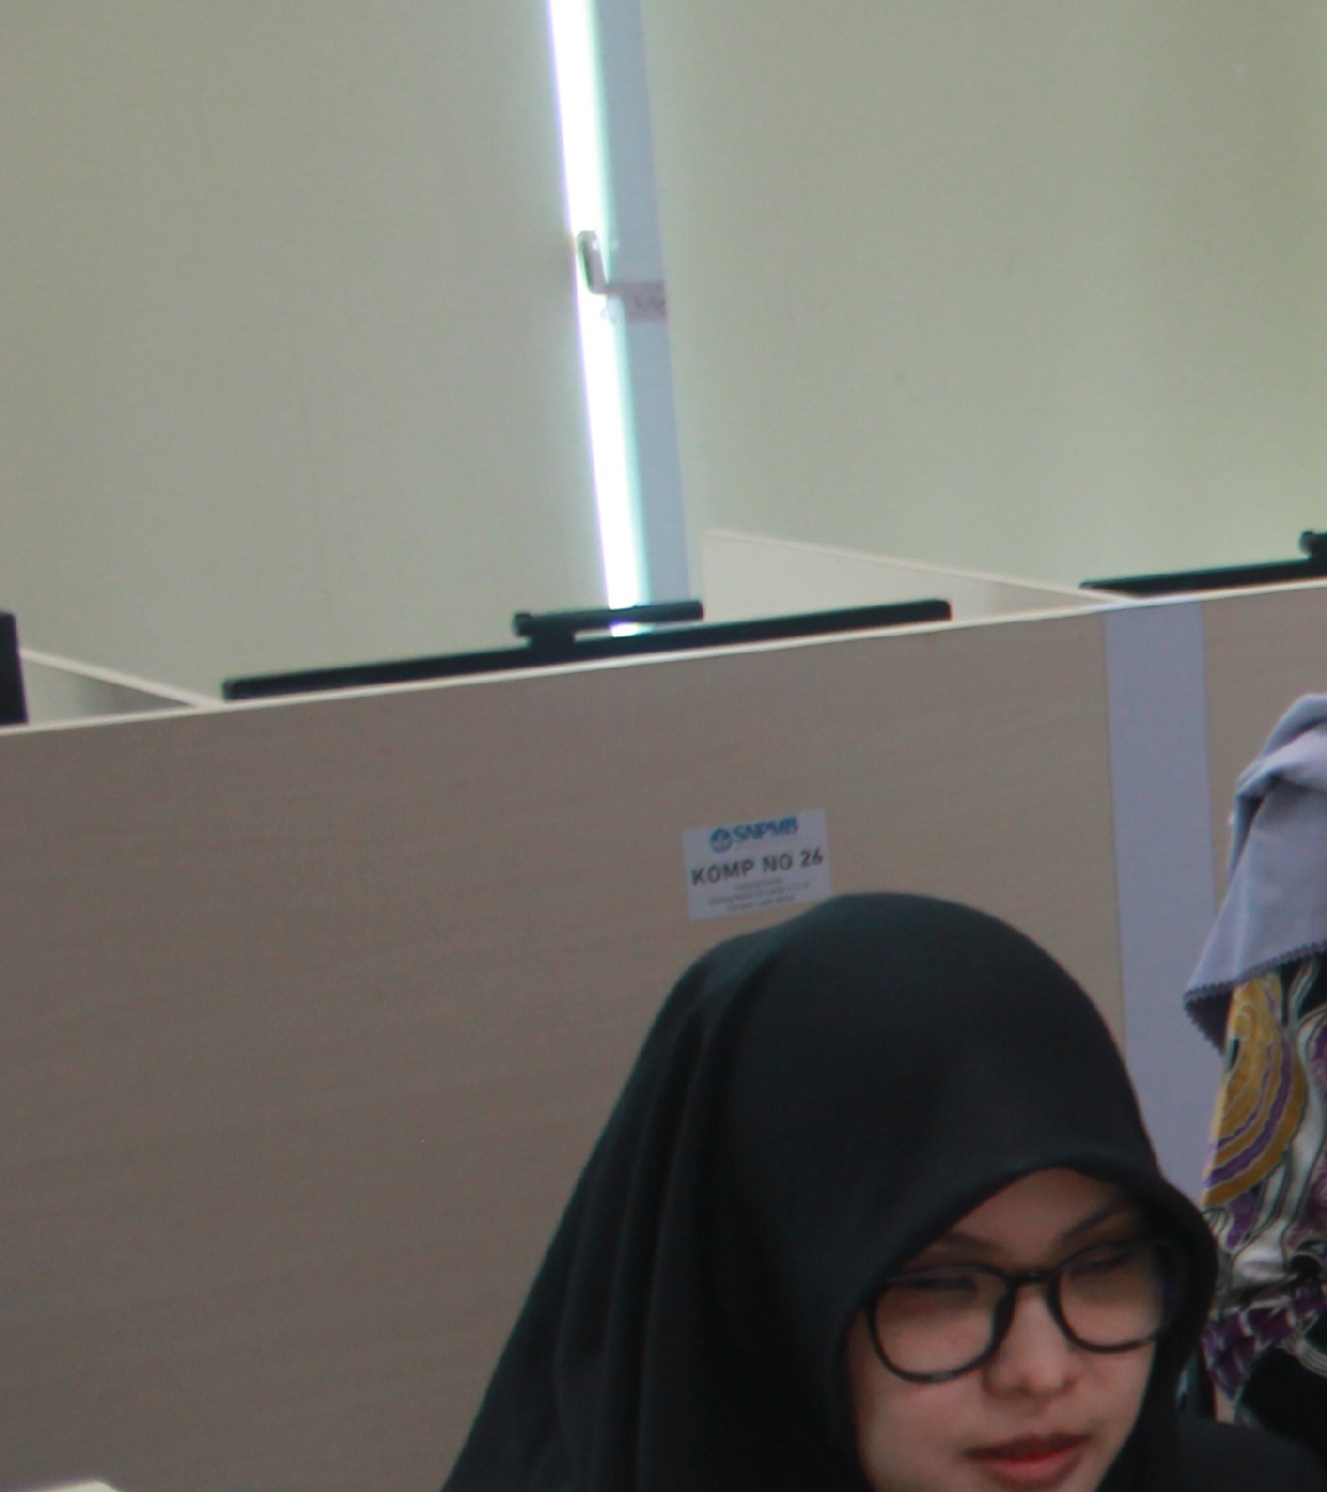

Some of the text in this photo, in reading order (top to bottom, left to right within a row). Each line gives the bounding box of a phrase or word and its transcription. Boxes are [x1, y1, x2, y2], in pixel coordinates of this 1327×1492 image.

[691, 859, 755, 886] KOMP
[762, 853, 793, 873] NO
[800, 847, 824, 868] 26
